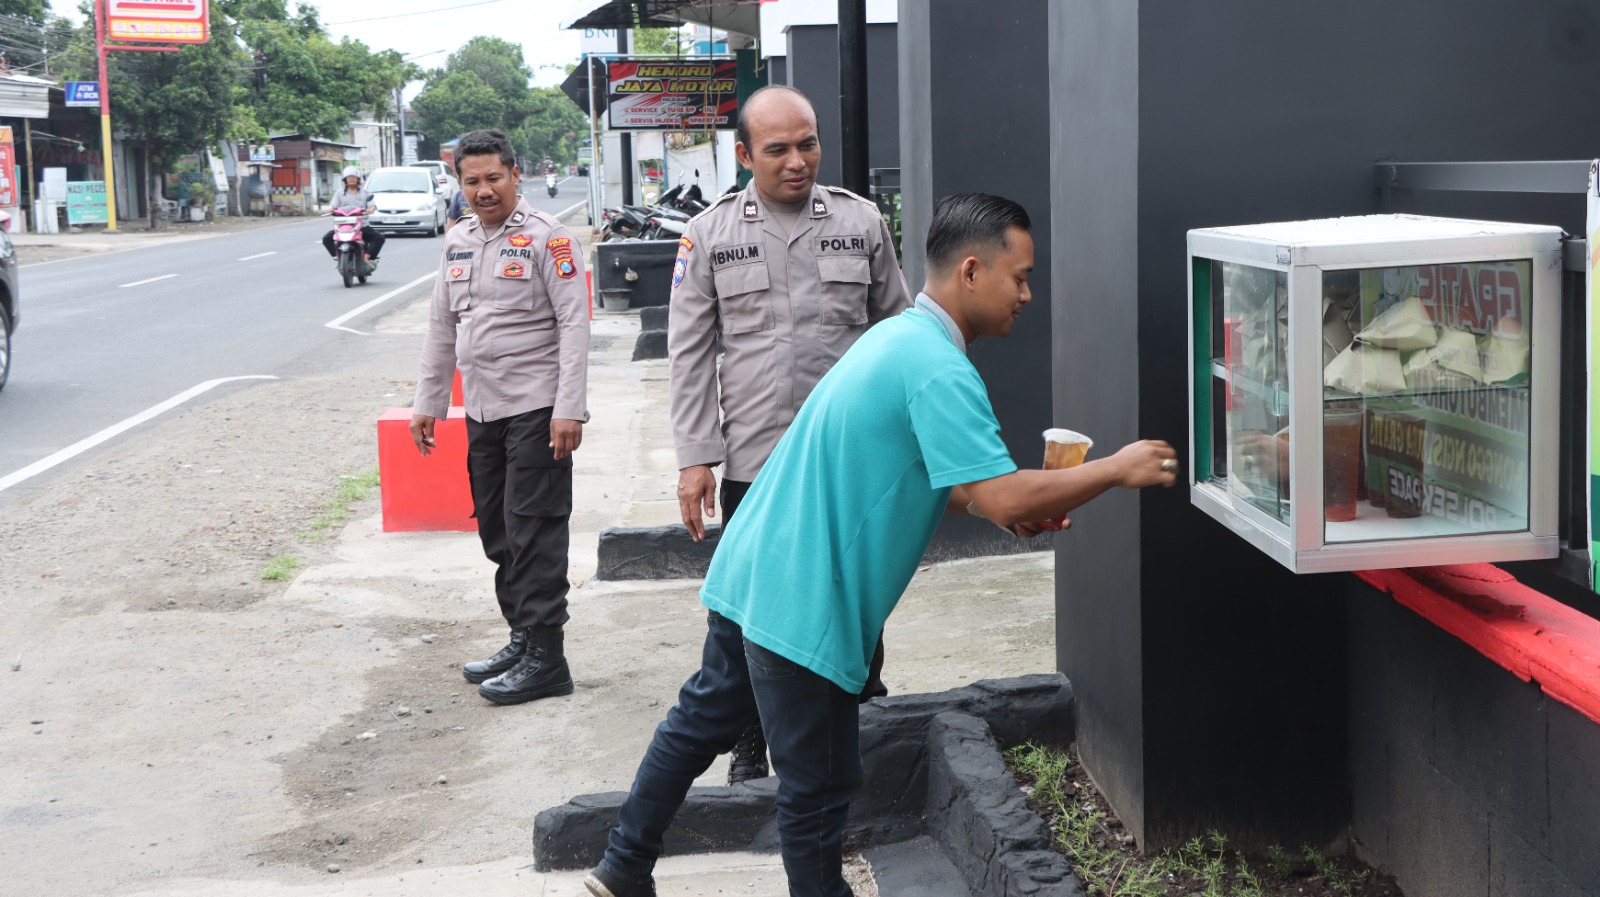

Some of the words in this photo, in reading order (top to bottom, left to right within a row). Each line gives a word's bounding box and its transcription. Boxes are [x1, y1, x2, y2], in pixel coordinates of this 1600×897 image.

[77, 84, 95, 92] ATM
[616, 81, 663, 92] JAYA
[668, 81, 734, 92] MOTOR
[820, 238, 865, 251] POLRI
[500, 249, 531, 259] POLRI
[713, 245, 760, 266] IBNU.M
